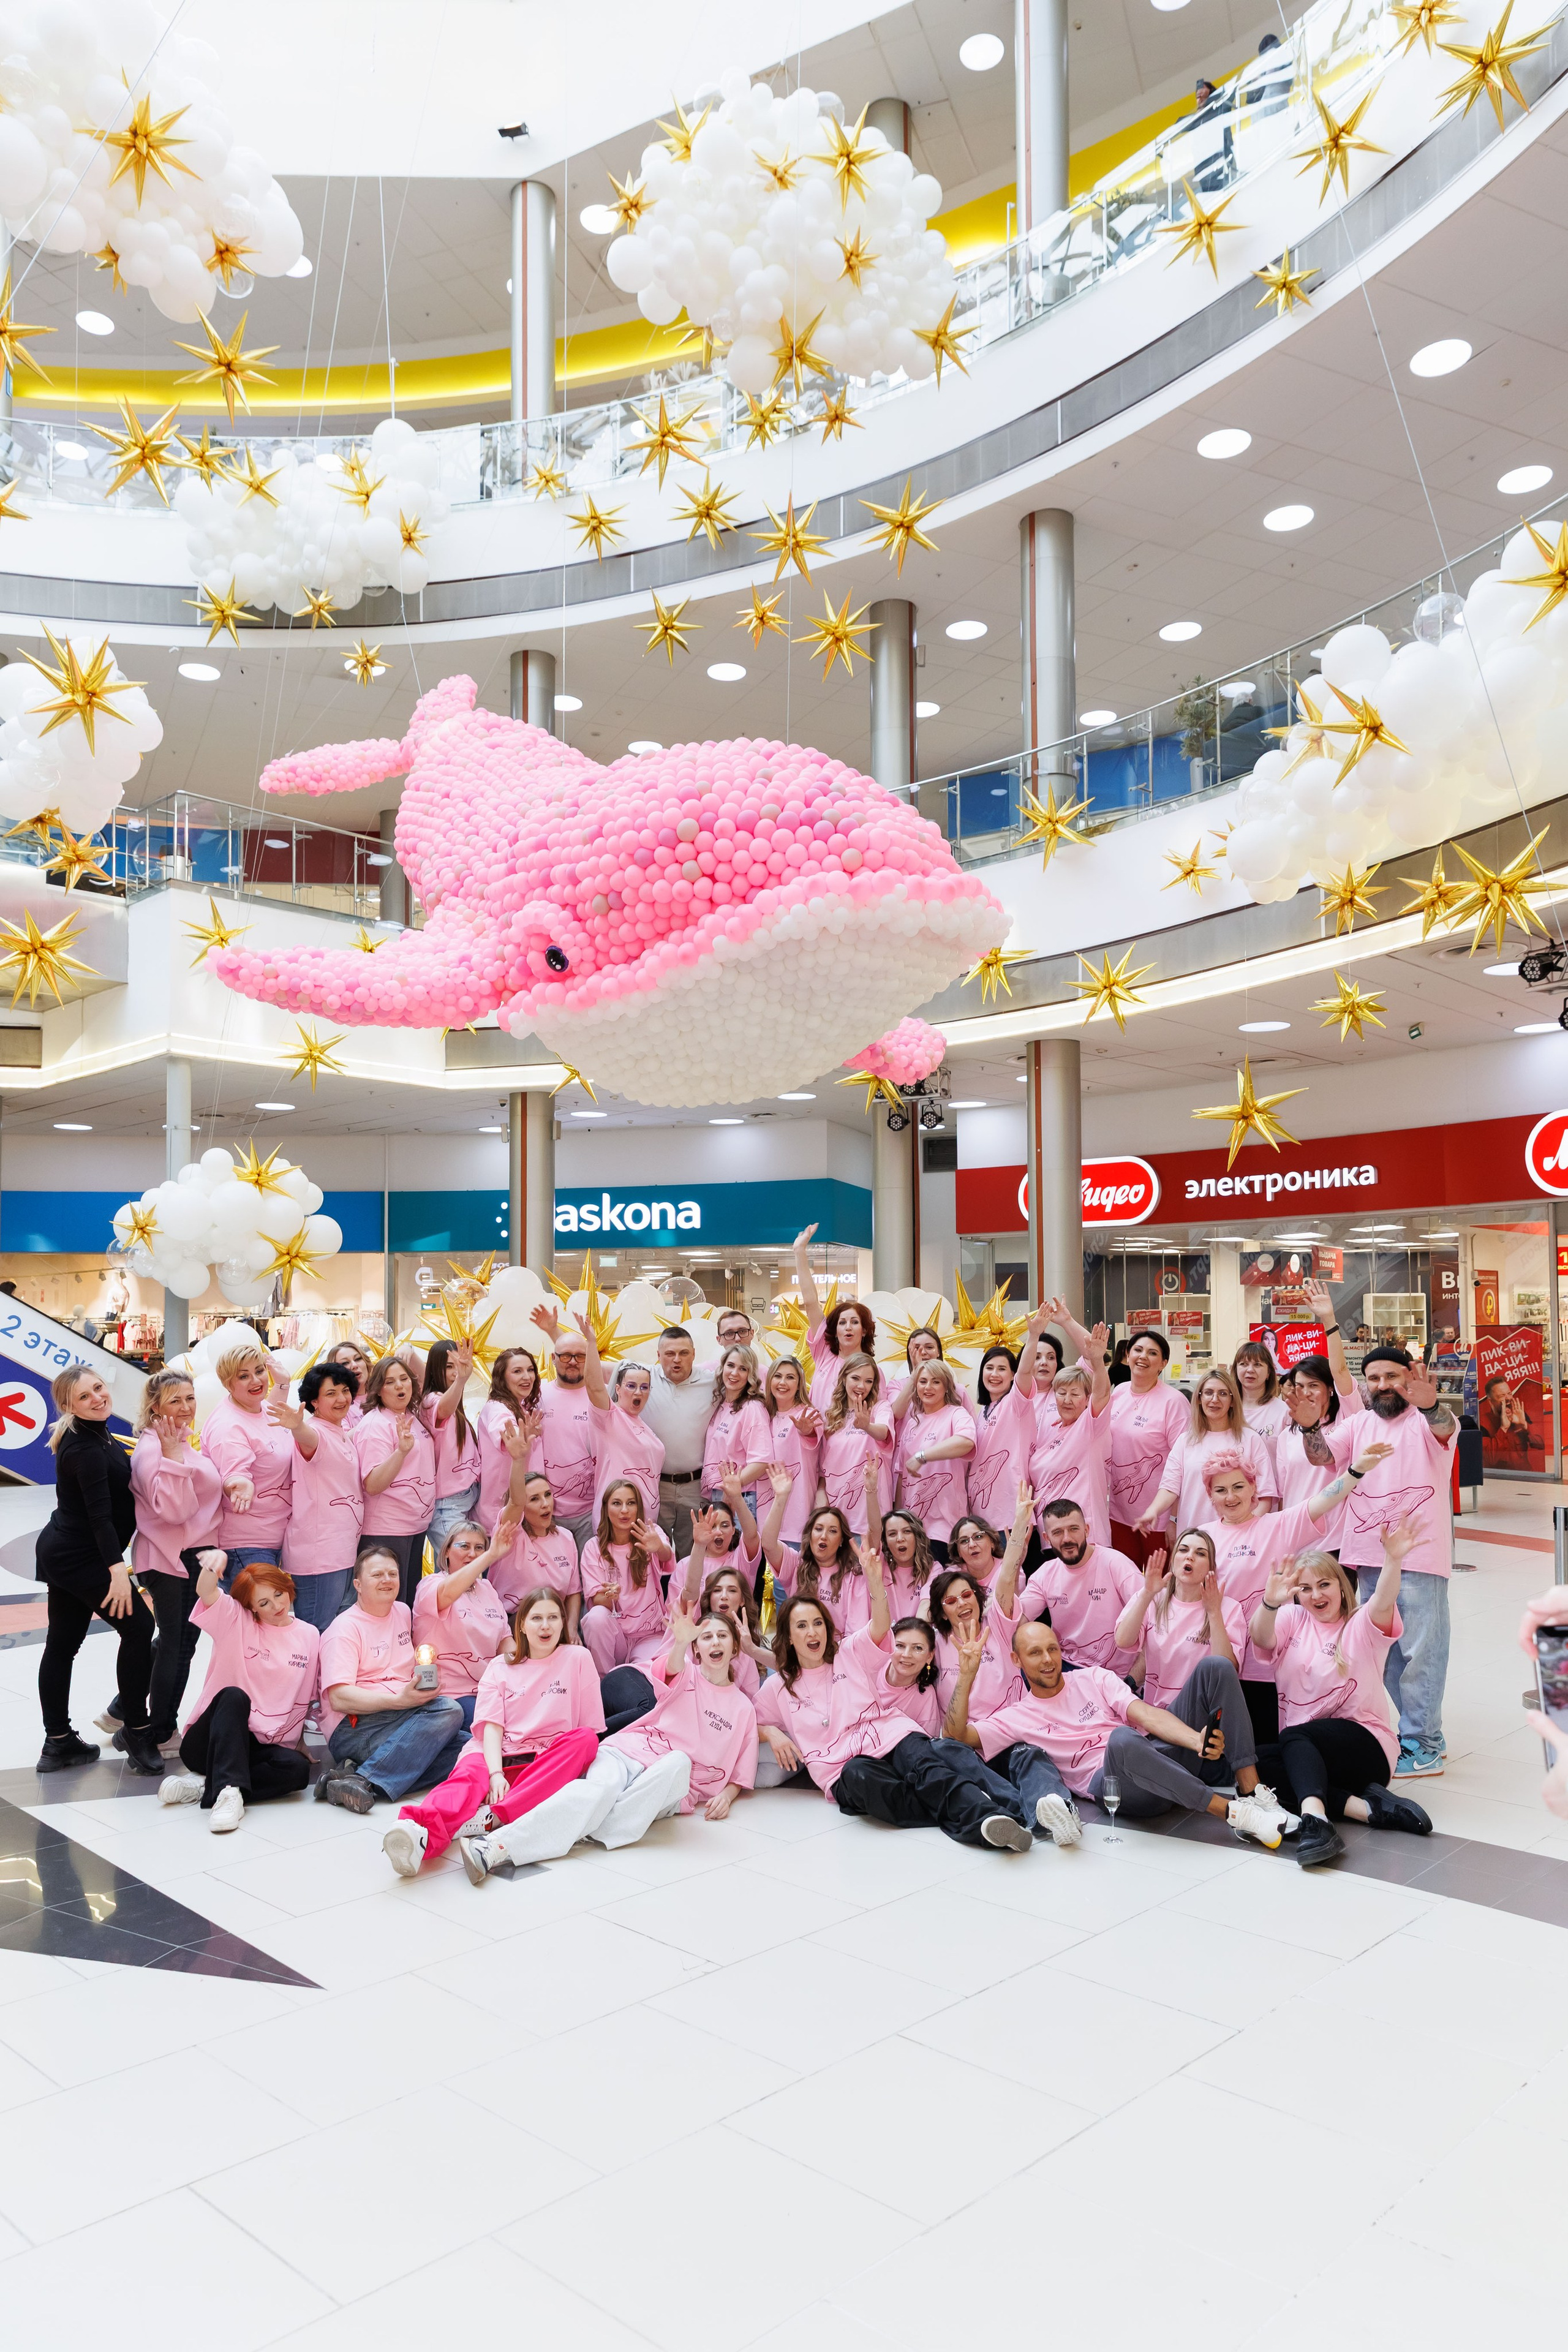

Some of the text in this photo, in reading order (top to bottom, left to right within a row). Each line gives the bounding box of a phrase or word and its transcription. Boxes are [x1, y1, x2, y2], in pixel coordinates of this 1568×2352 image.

[1185, 1164, 1378, 1202] электроника
[555, 1193, 701, 1232] askona
[791, 1273, 857, 1285] ПТЕЛЬНОЕ
[0, 1315, 21, 1339] 2
[1286, 1330, 1322, 1343] ЛИК-ВИ-
[1480, 1339, 1531, 1363] ЛИК-ВИ-
[1485, 1353, 1529, 1377] ДА-ЦИ-
[1504, 1362, 1540, 1382] ЯЯЯ!!!
[704, 1709, 733, 1730] АЛЕКСАНДРА
[1079, 1706, 1101, 1724] БУЛДАКО
[709, 1721, 722, 1732] ДУДА
